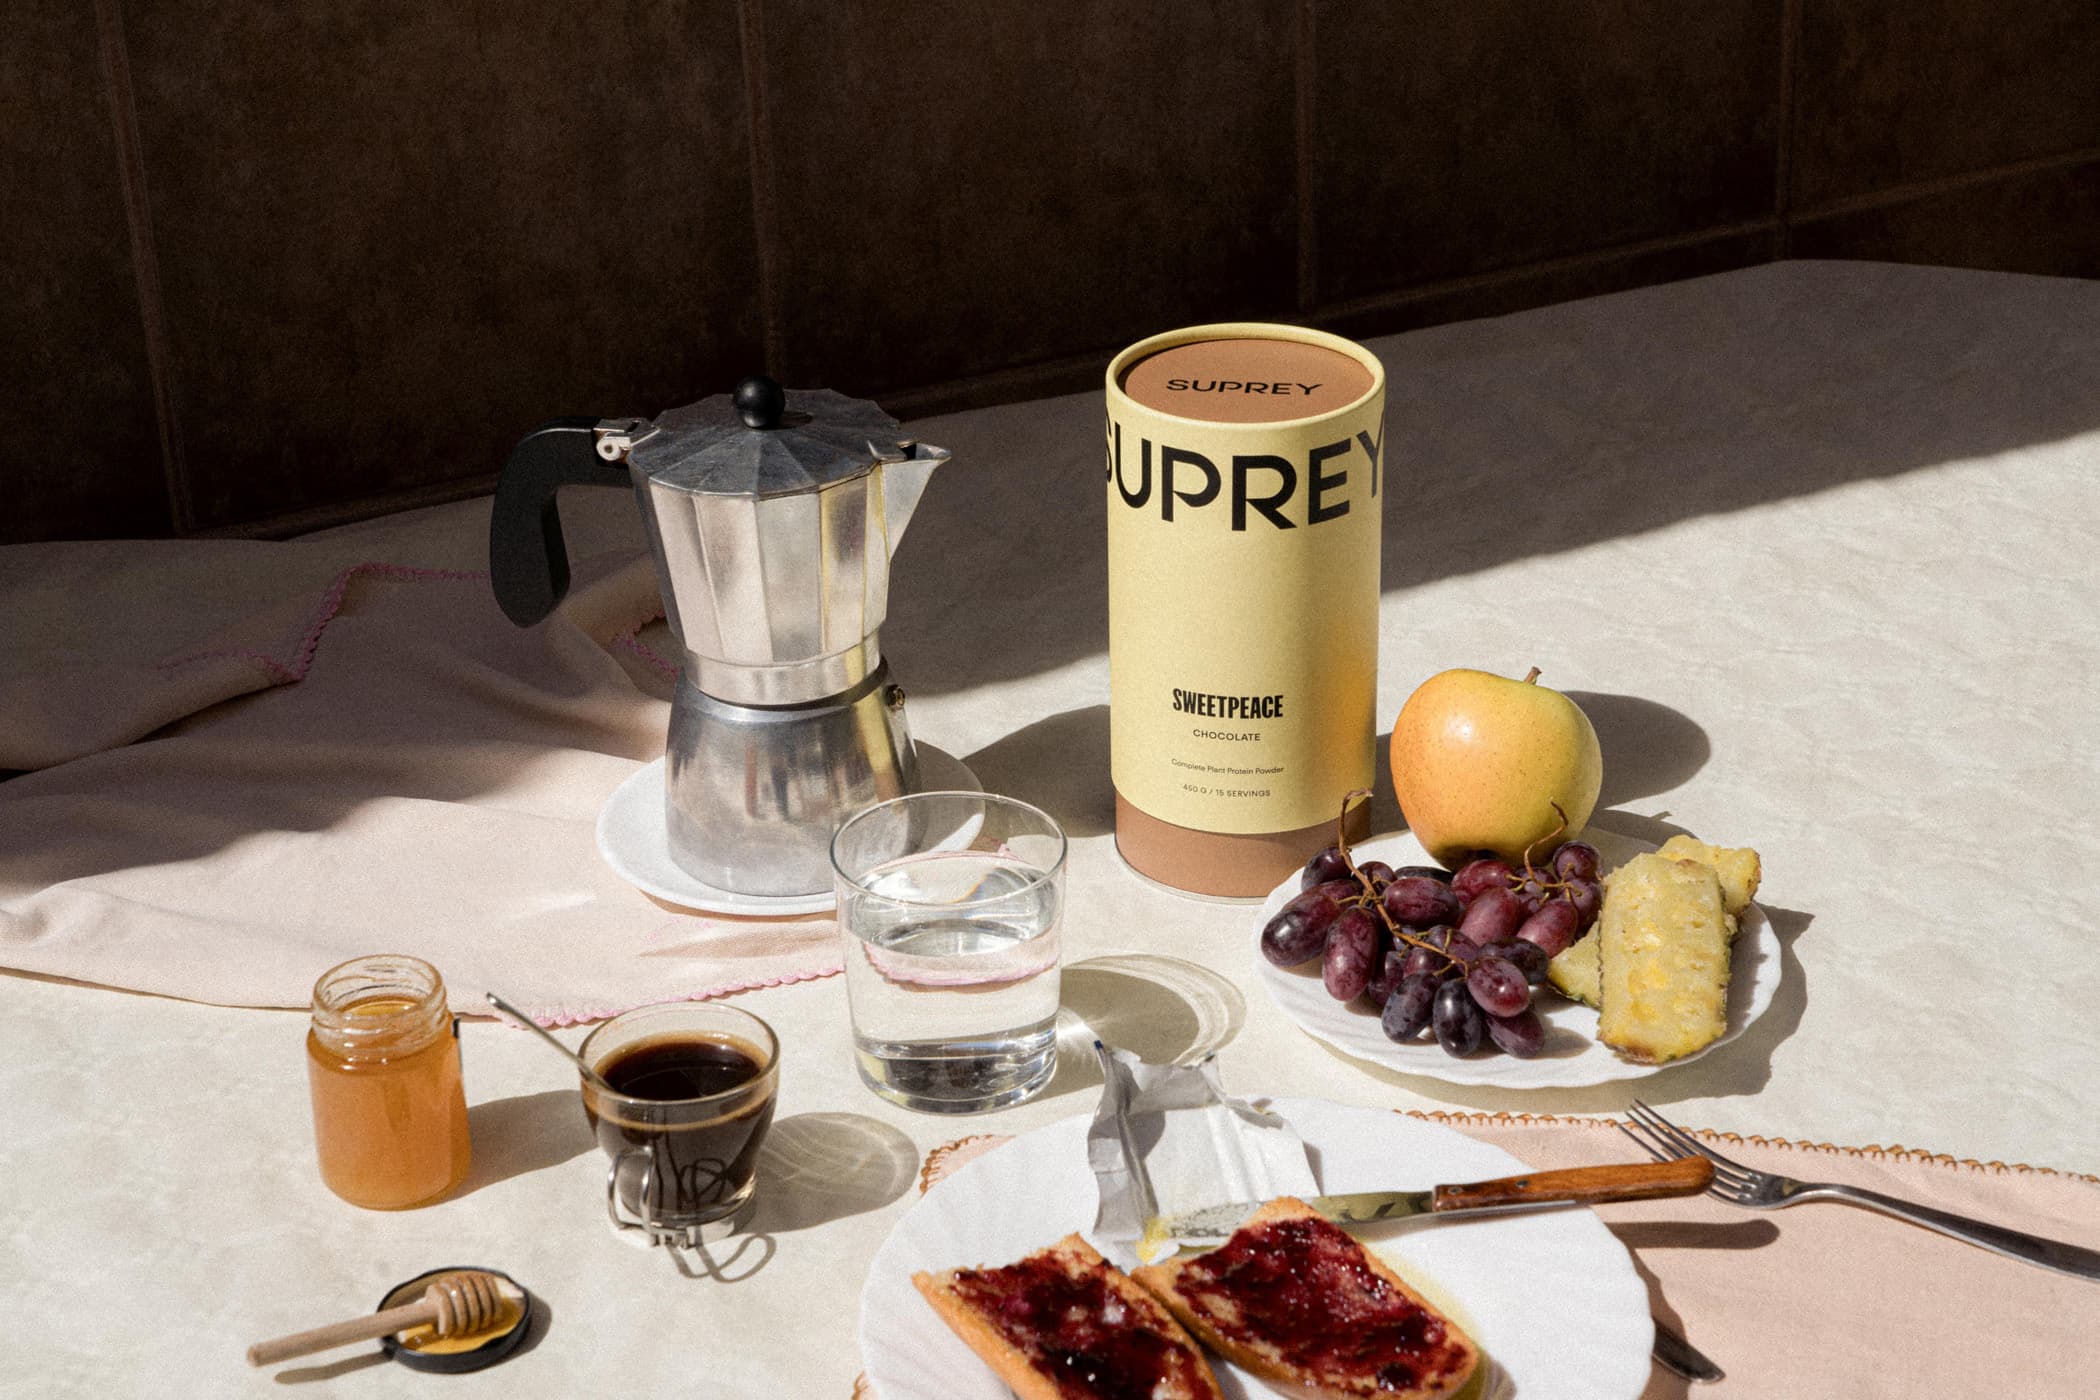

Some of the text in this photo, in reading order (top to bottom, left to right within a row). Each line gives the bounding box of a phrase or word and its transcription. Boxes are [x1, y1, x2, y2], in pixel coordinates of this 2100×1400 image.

[1166, 379, 1324, 395] SUPREY
[1172, 688, 1284, 719] SWEETPEACE
[1193, 729, 1261, 741] CHOCOLATE
[1171, 758, 1285, 775] Complete Plant Protein Powder
[1183, 783, 1199, 793] 450
[1215, 788, 1225, 797] 15
[1226, 789, 1271, 797] SERVINGS
